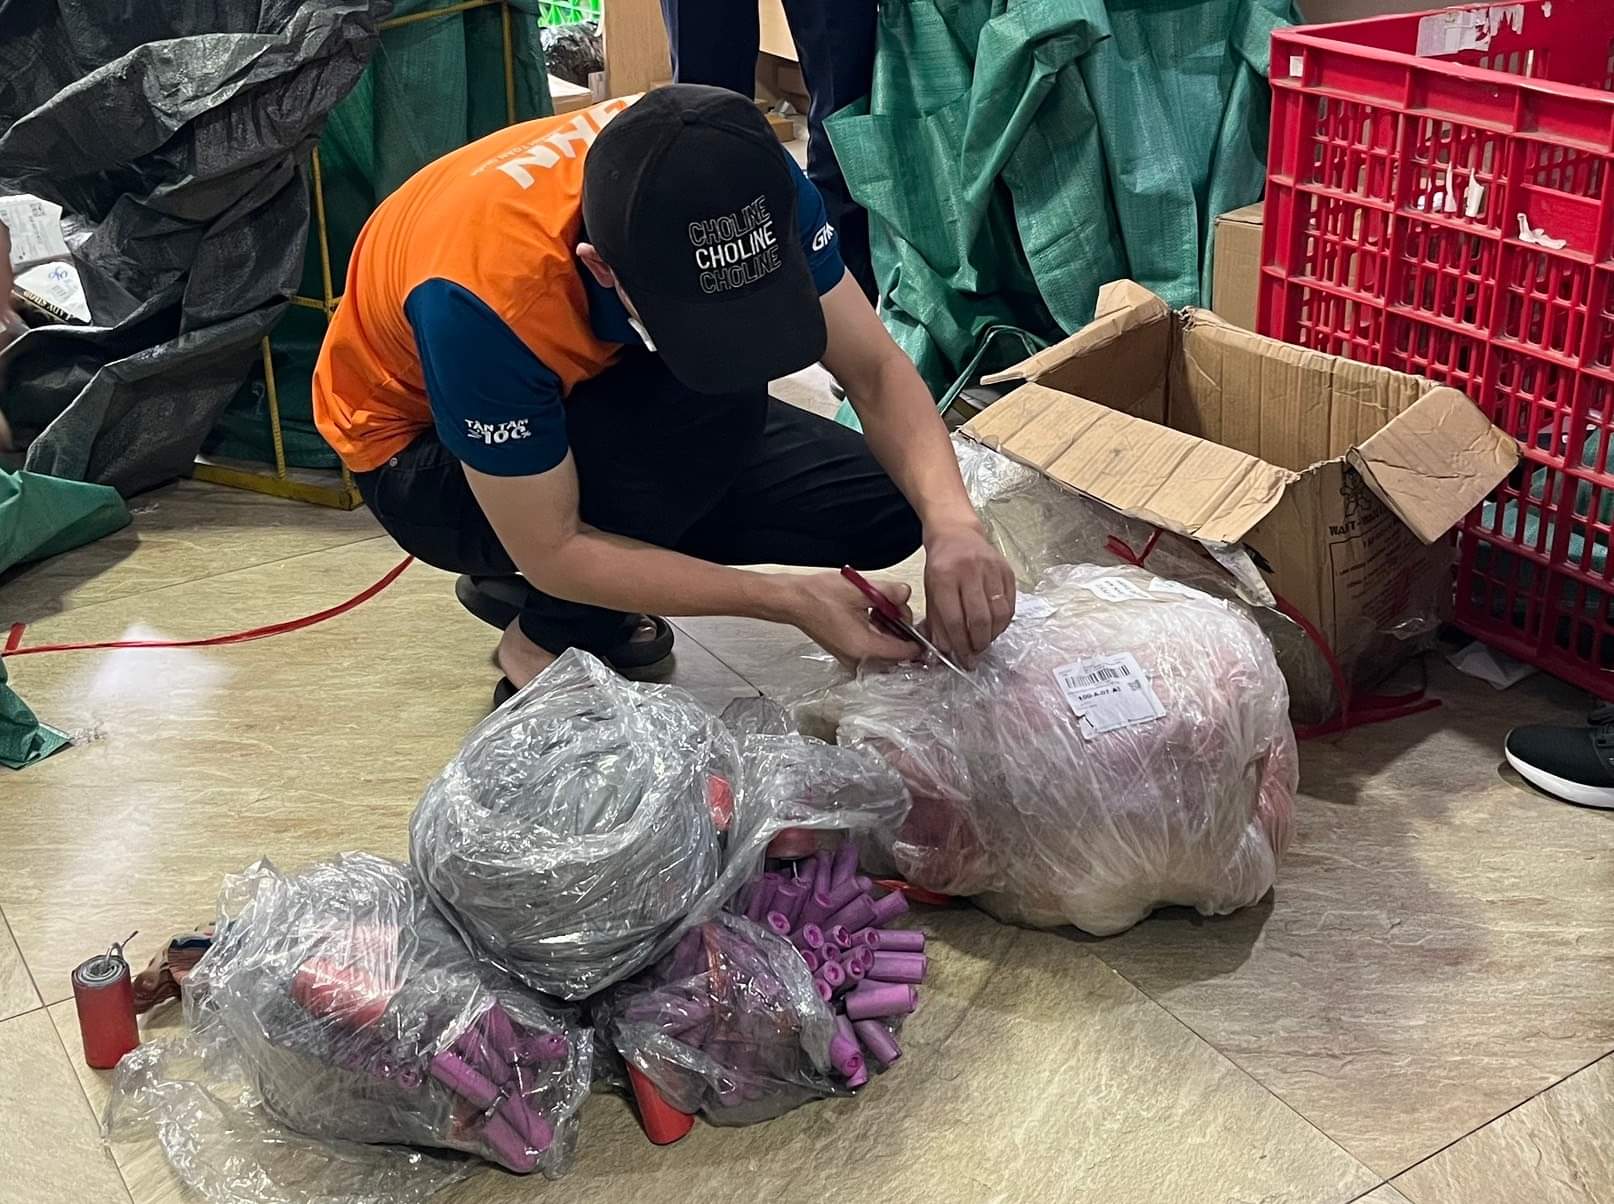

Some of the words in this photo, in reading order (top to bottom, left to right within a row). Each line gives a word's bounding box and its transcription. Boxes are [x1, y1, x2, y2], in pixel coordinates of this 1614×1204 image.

[688, 195, 771, 247] CHOLINE
[695, 221, 777, 270] CHOLINE
[699, 245, 782, 294] CHOLINE
